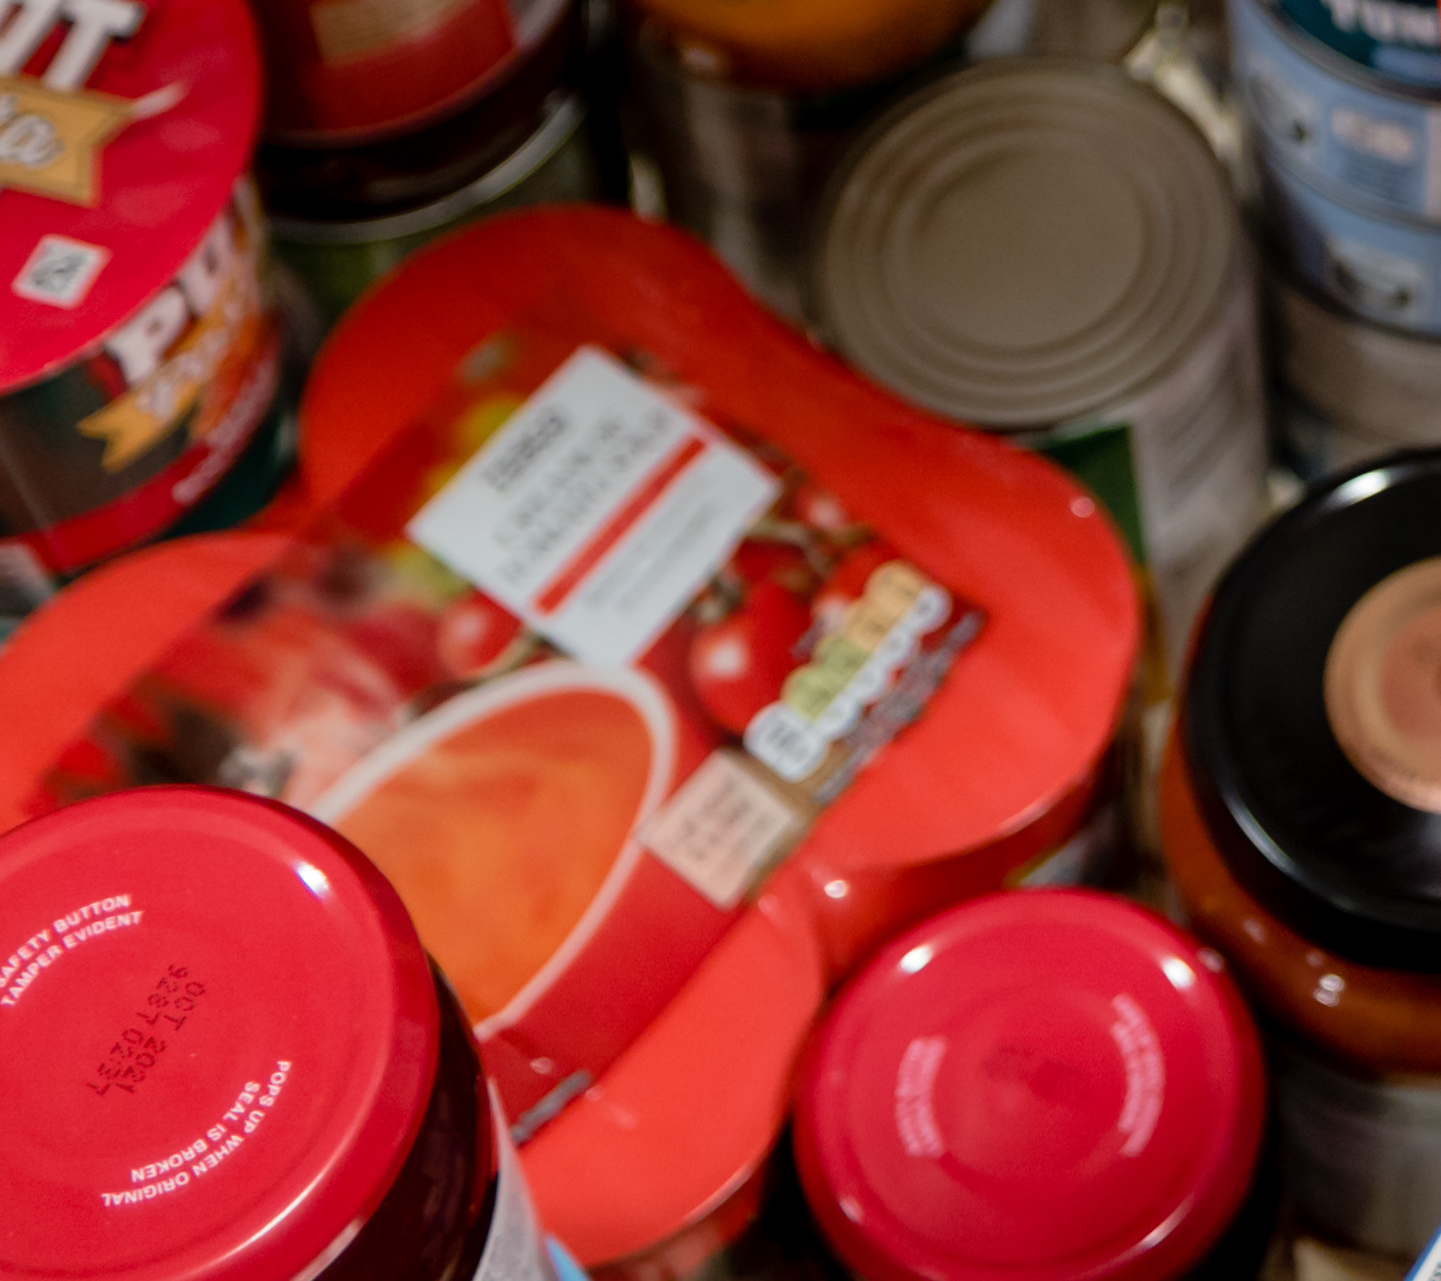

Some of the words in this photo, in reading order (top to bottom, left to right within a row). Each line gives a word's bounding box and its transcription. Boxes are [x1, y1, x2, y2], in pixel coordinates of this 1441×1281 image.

[53, 894, 132, 933] BUTTON
[0, 945, 63, 1006] TAMPER
[62, 911, 144, 949] EVIDENT
[163, 981, 206, 1032] OCT
[116, 1036, 167, 1093] 2021
[260, 1061, 292, 1107] POPS
[222, 1081, 261, 1122] SEAL
[244, 1110, 265, 1134] UP
[206, 1124, 227, 1141] IS
[131, 1139, 208, 1182] BROKEN
[192, 1135, 245, 1177] WHEN
[101, 1171, 190, 1207] ORIGINAL
